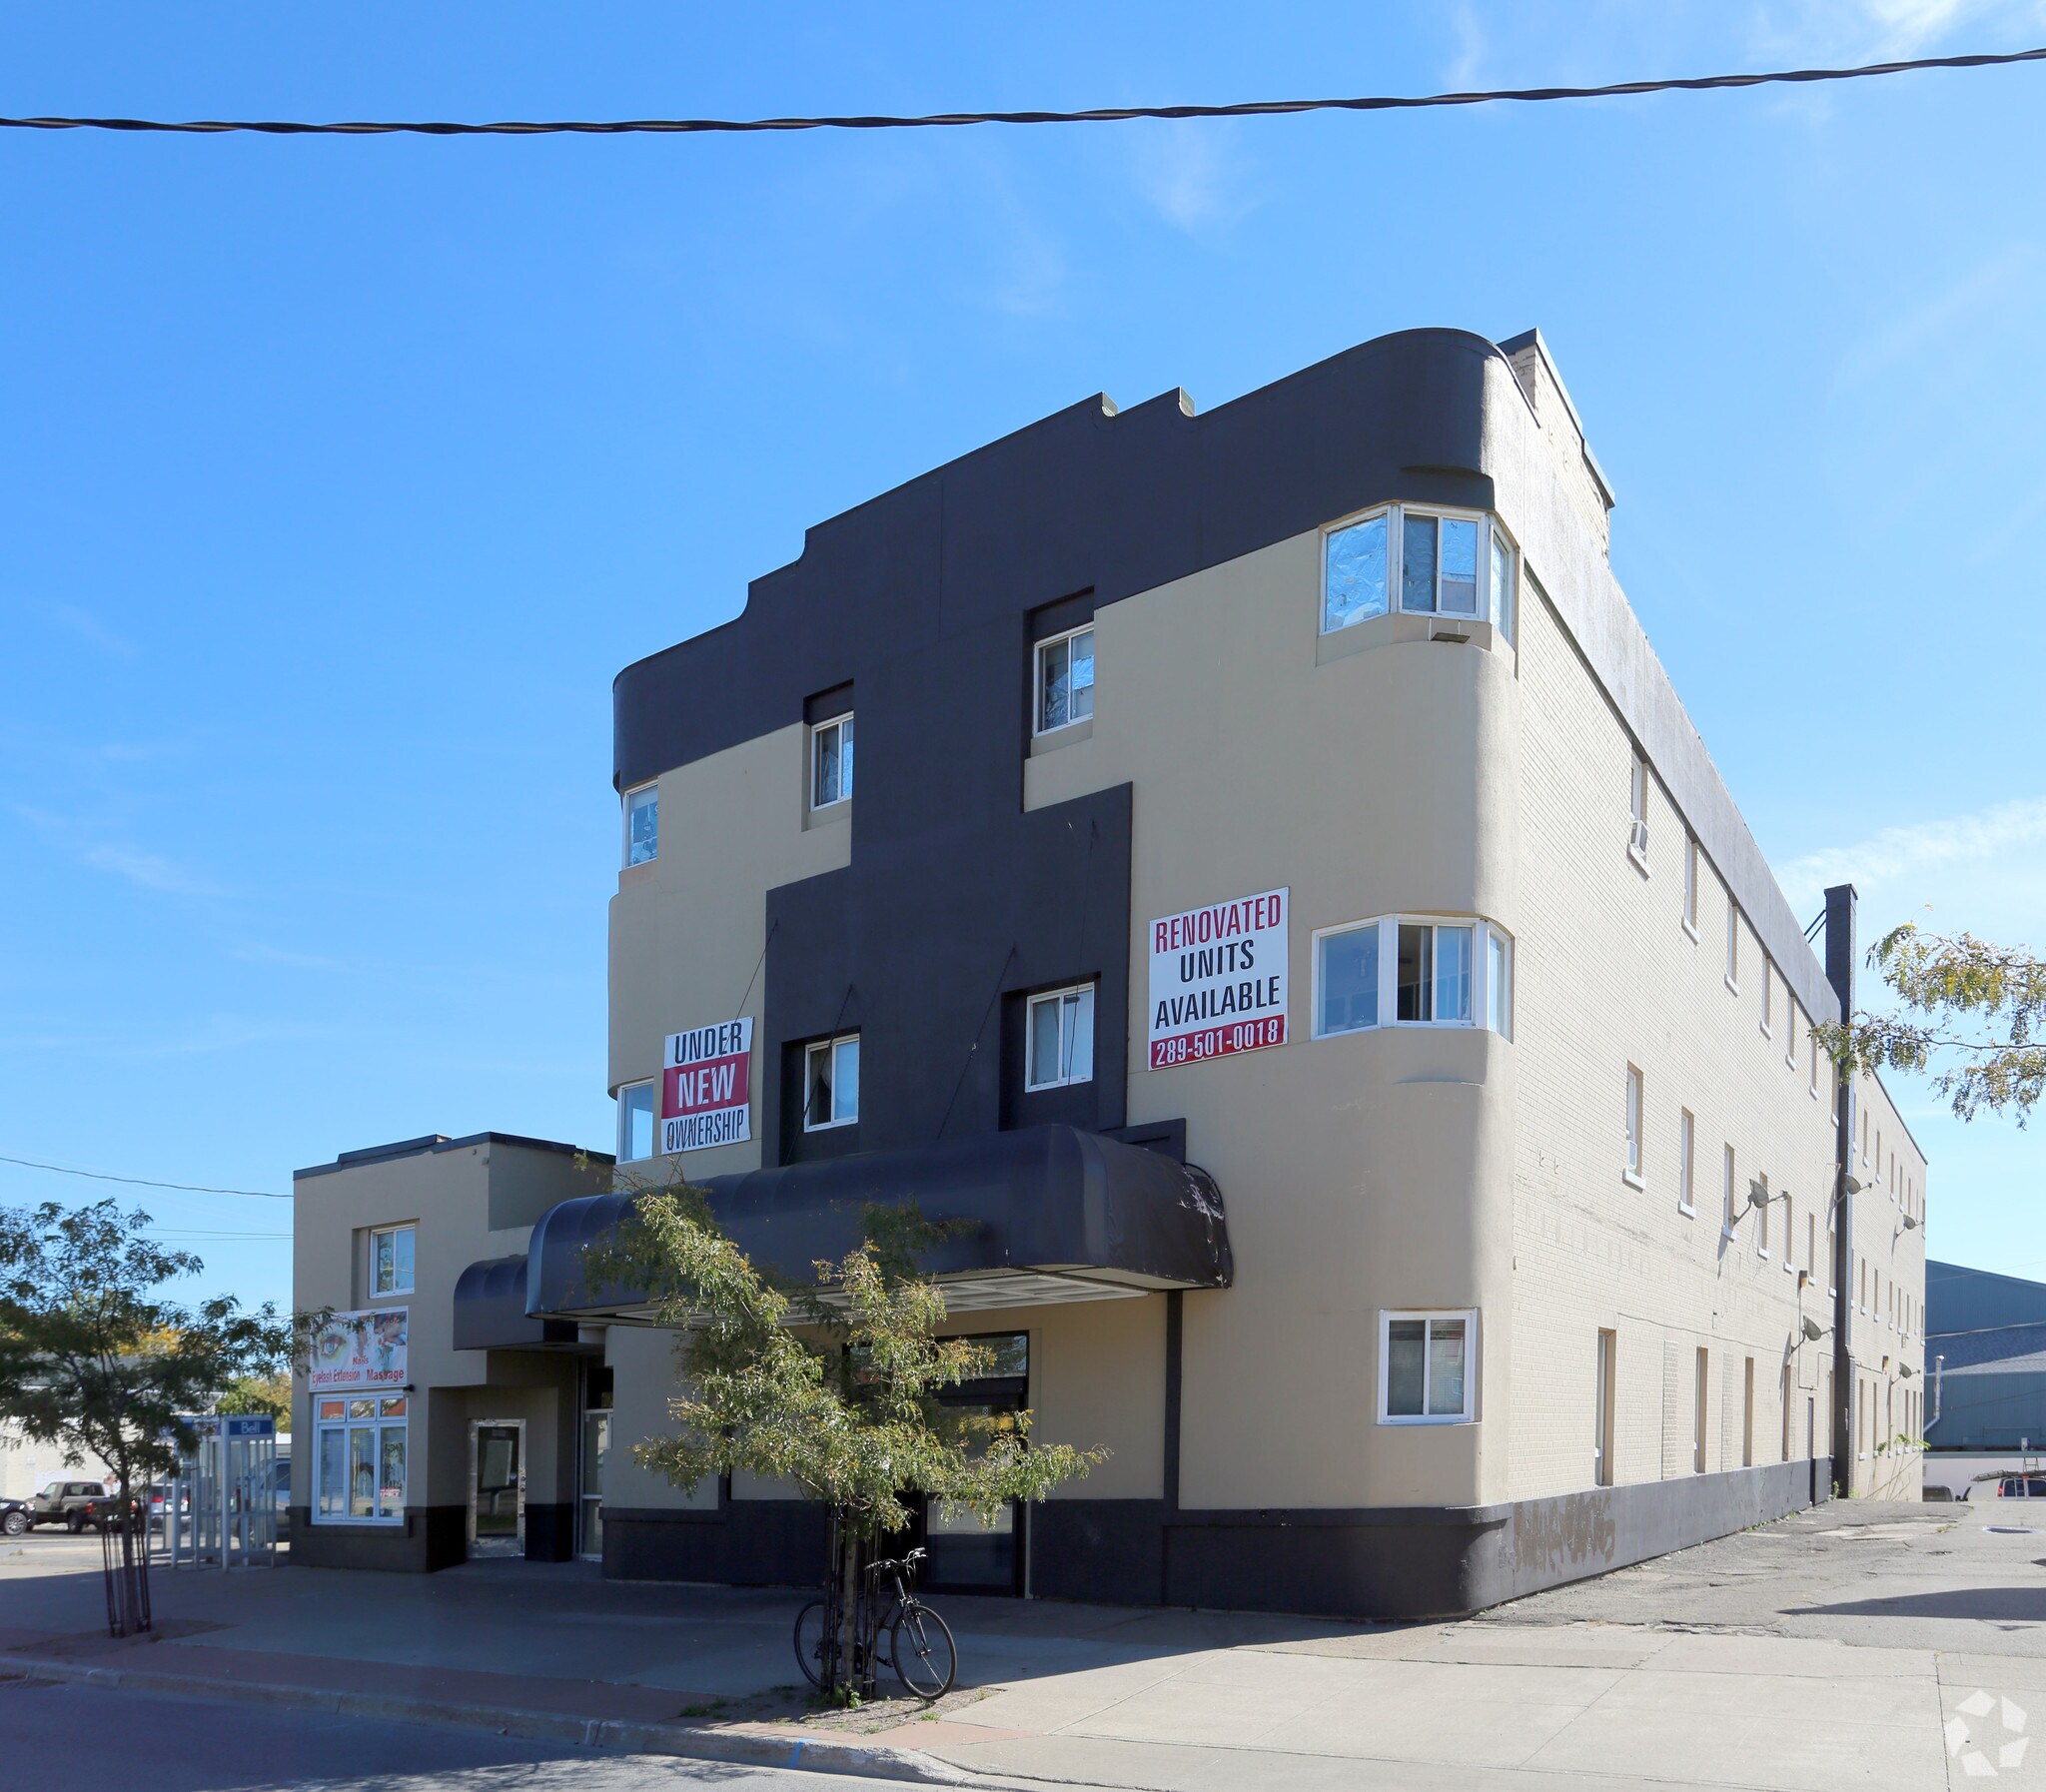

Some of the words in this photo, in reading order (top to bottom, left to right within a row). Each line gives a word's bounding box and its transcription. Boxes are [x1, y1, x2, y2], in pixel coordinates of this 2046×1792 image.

[1155, 894, 1281, 954] RENOVATED
[1180, 939, 1255, 983] UNITS
[1154, 975, 1281, 1030] AVAILABLE
[674, 1022, 742, 1065] UNDER
[1155, 1019, 1279, 1066] 289-501-0018
[678, 1063, 736, 1109] NEW
[666, 1109, 744, 1151] OWNERSHIP
[241, 1421, 260, 1434] Bell
